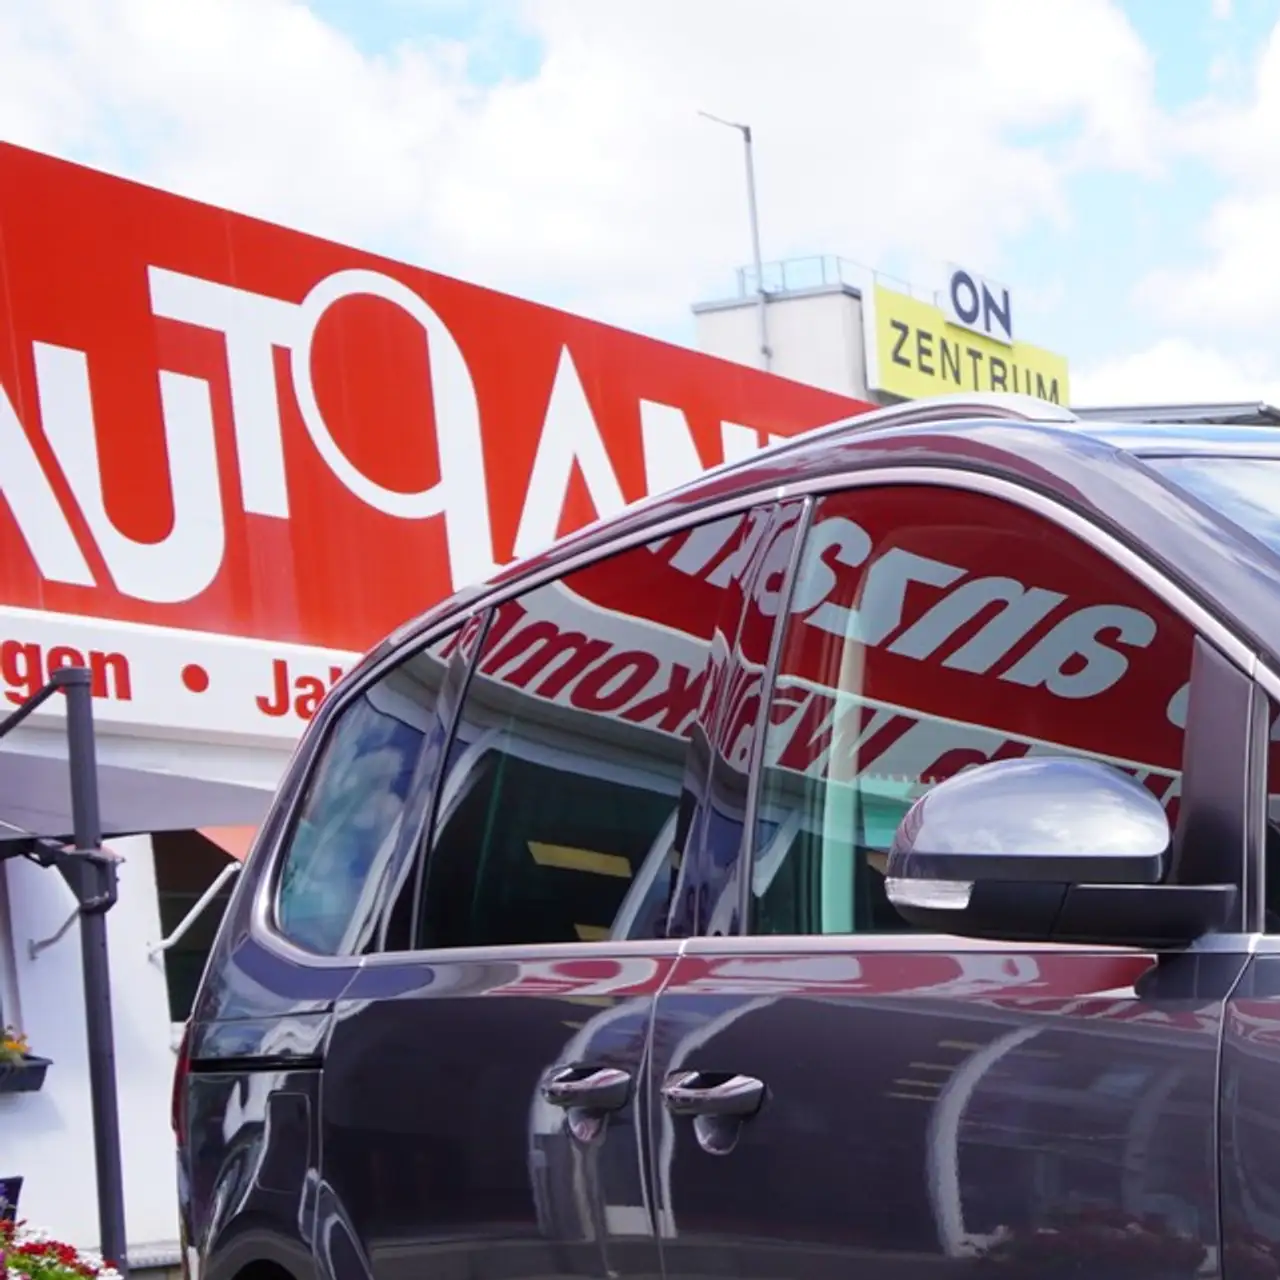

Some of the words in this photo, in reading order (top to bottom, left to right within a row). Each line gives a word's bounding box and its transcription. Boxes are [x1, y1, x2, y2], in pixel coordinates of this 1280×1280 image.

[950, 269, 1012, 339] ON
[889, 317, 1060, 405] ZENTRUM
[0, 265, 795, 604] UTOLAN
[256, 659, 343, 719] Ja
